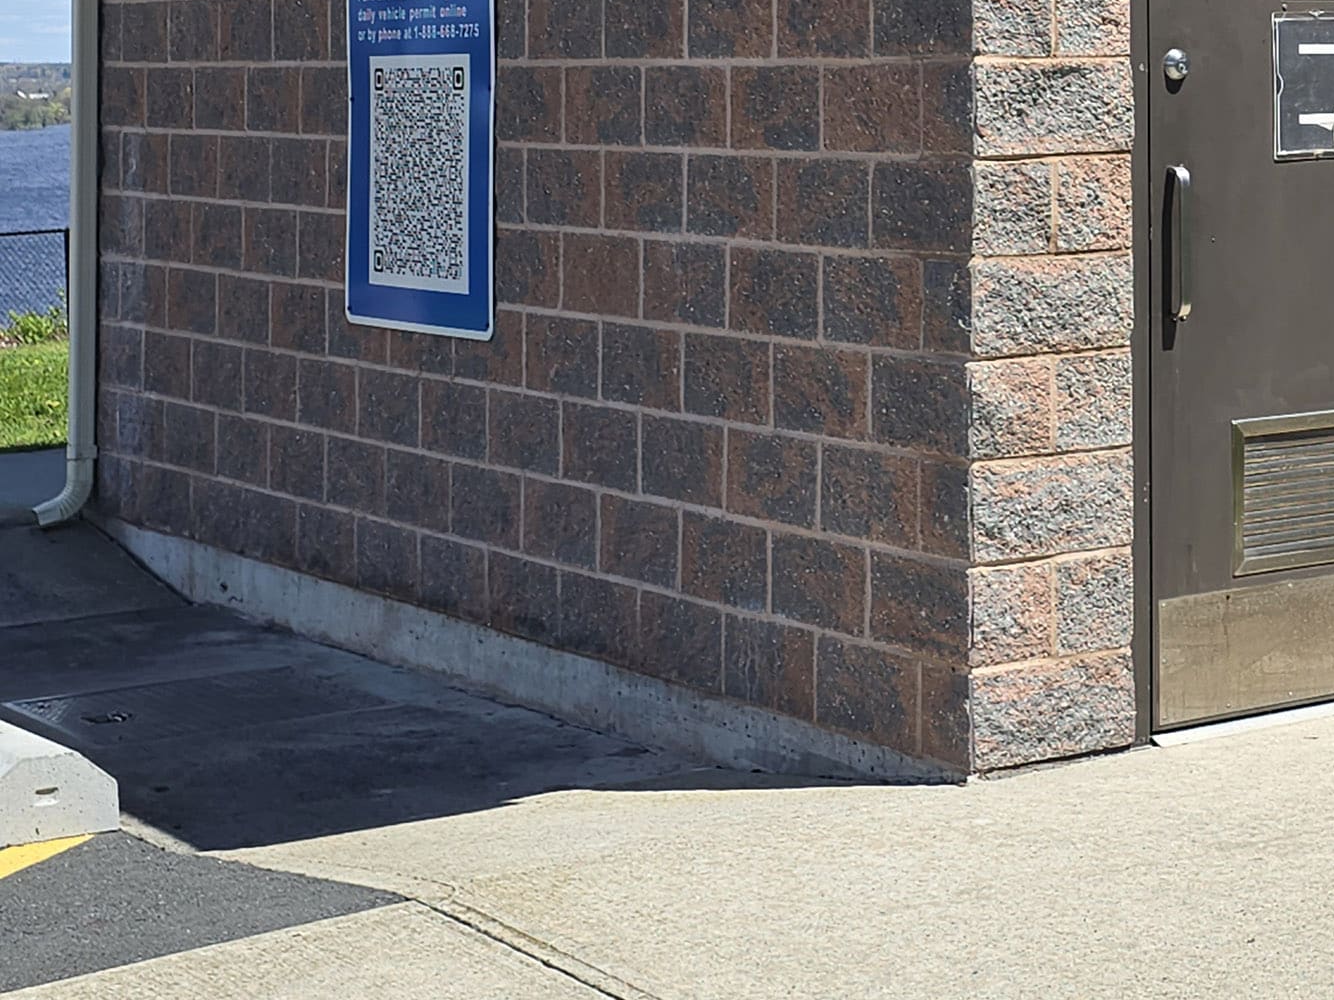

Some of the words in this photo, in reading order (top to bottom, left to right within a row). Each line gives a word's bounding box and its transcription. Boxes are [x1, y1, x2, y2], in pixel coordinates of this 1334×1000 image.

[358, 8, 375, 24] daily
[378, 6, 406, 21] vehicle
[409, 5, 436, 21] permit
[440, 5, 467, 18] online
[358, 31, 366, 41] or
[368, 28, 376, 43] by
[378, 28, 401, 42] phone
[404, 27, 412, 39] at
[414, 24, 479, 38] 1-888-668-7275
